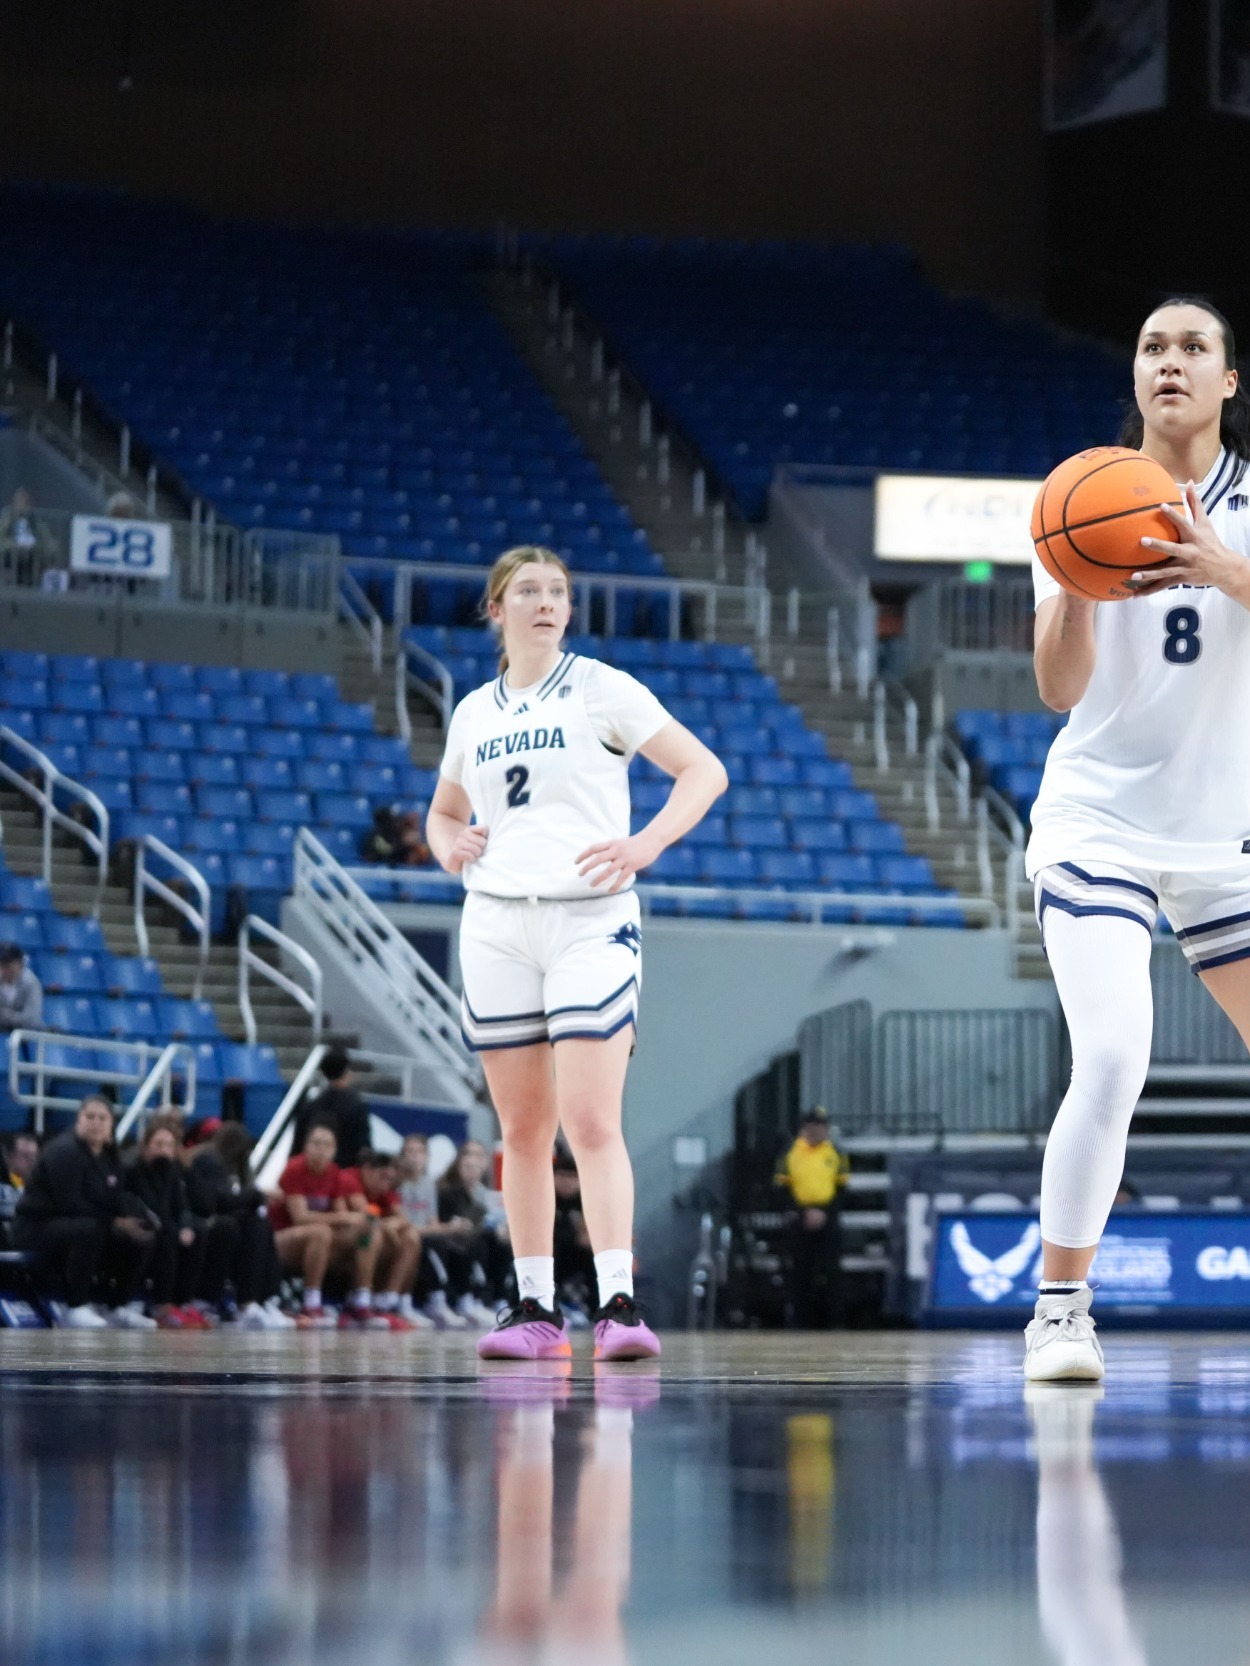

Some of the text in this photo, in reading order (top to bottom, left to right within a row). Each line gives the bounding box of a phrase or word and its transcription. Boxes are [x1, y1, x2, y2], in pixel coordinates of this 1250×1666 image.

[87, 524, 155, 568] 28
[1162, 604, 1203, 666] 8
[476, 726, 566, 766] NEVADA
[505, 763, 531, 808] 2
